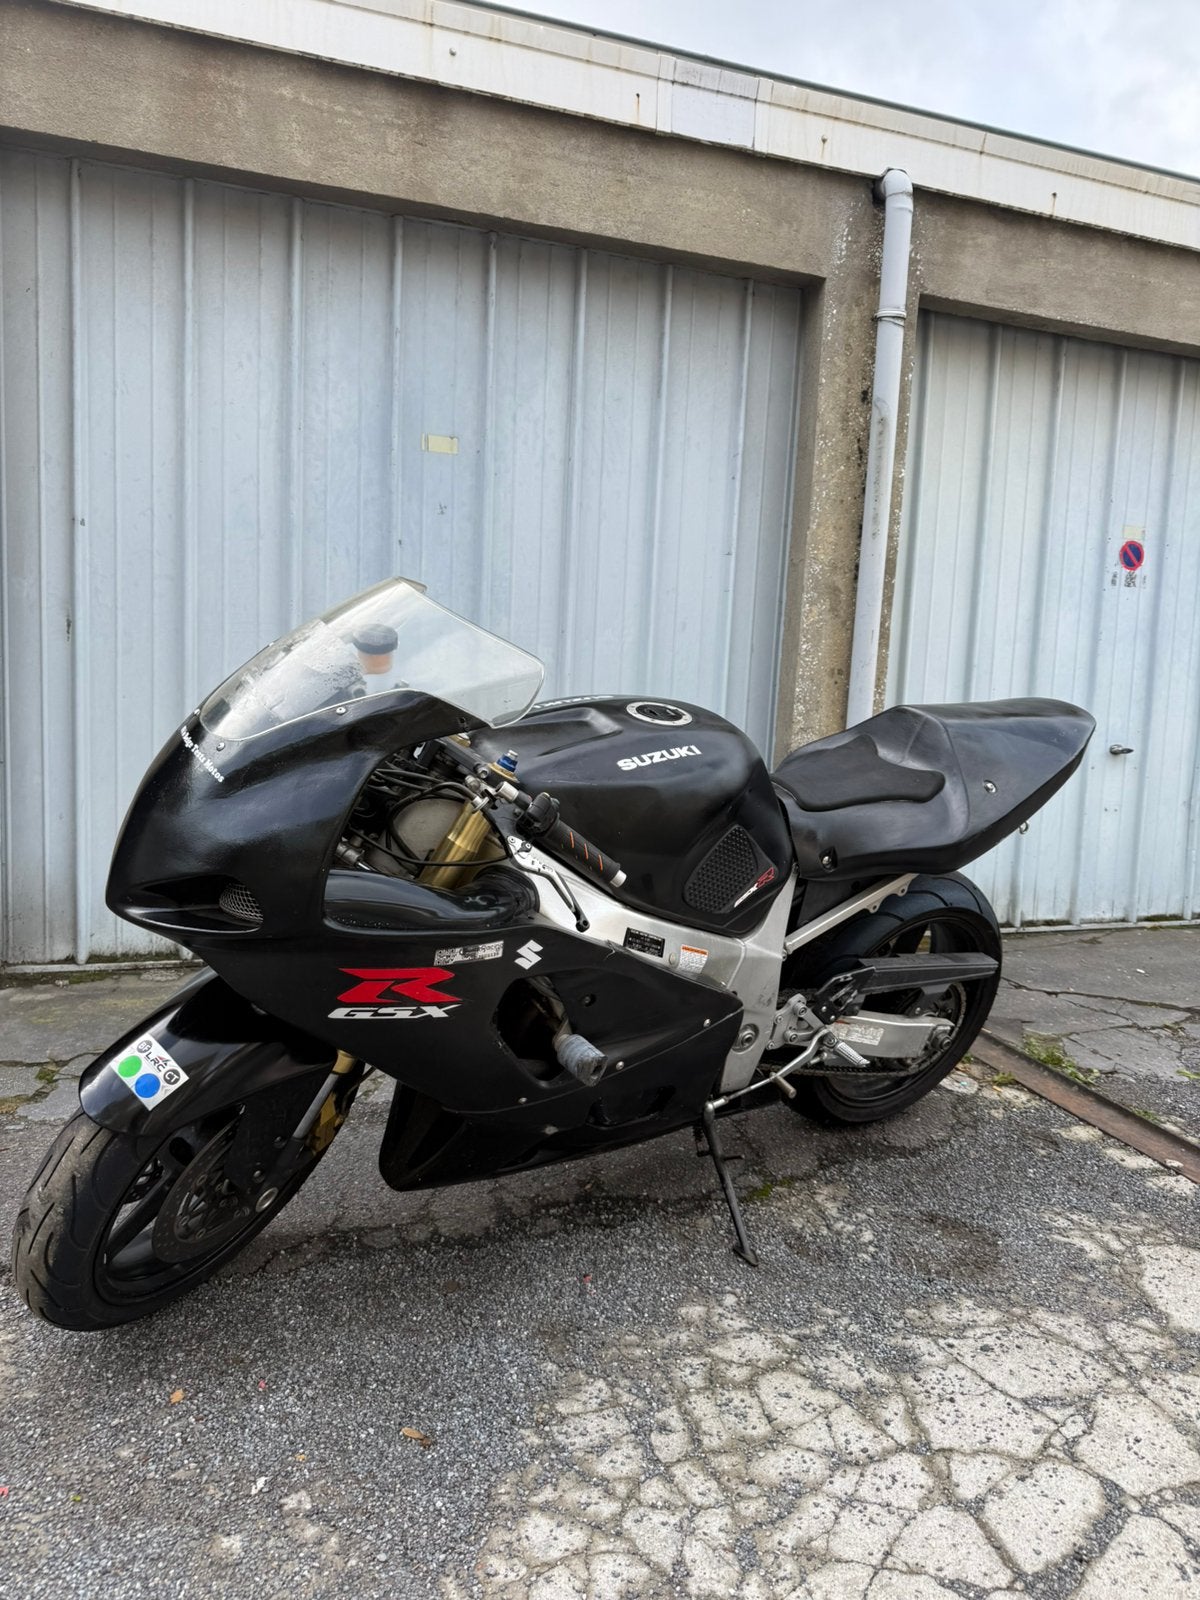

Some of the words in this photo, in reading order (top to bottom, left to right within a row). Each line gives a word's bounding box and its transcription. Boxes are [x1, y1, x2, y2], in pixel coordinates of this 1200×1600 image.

[616, 744, 702, 772] SUZUKI
[203, 759, 225, 783] Motos
[336, 967, 463, 1004] R
[327, 1003, 463, 1019] GSX
[145, 1051, 166, 1073] LRC
[164, 1070, 180, 1083] CT
